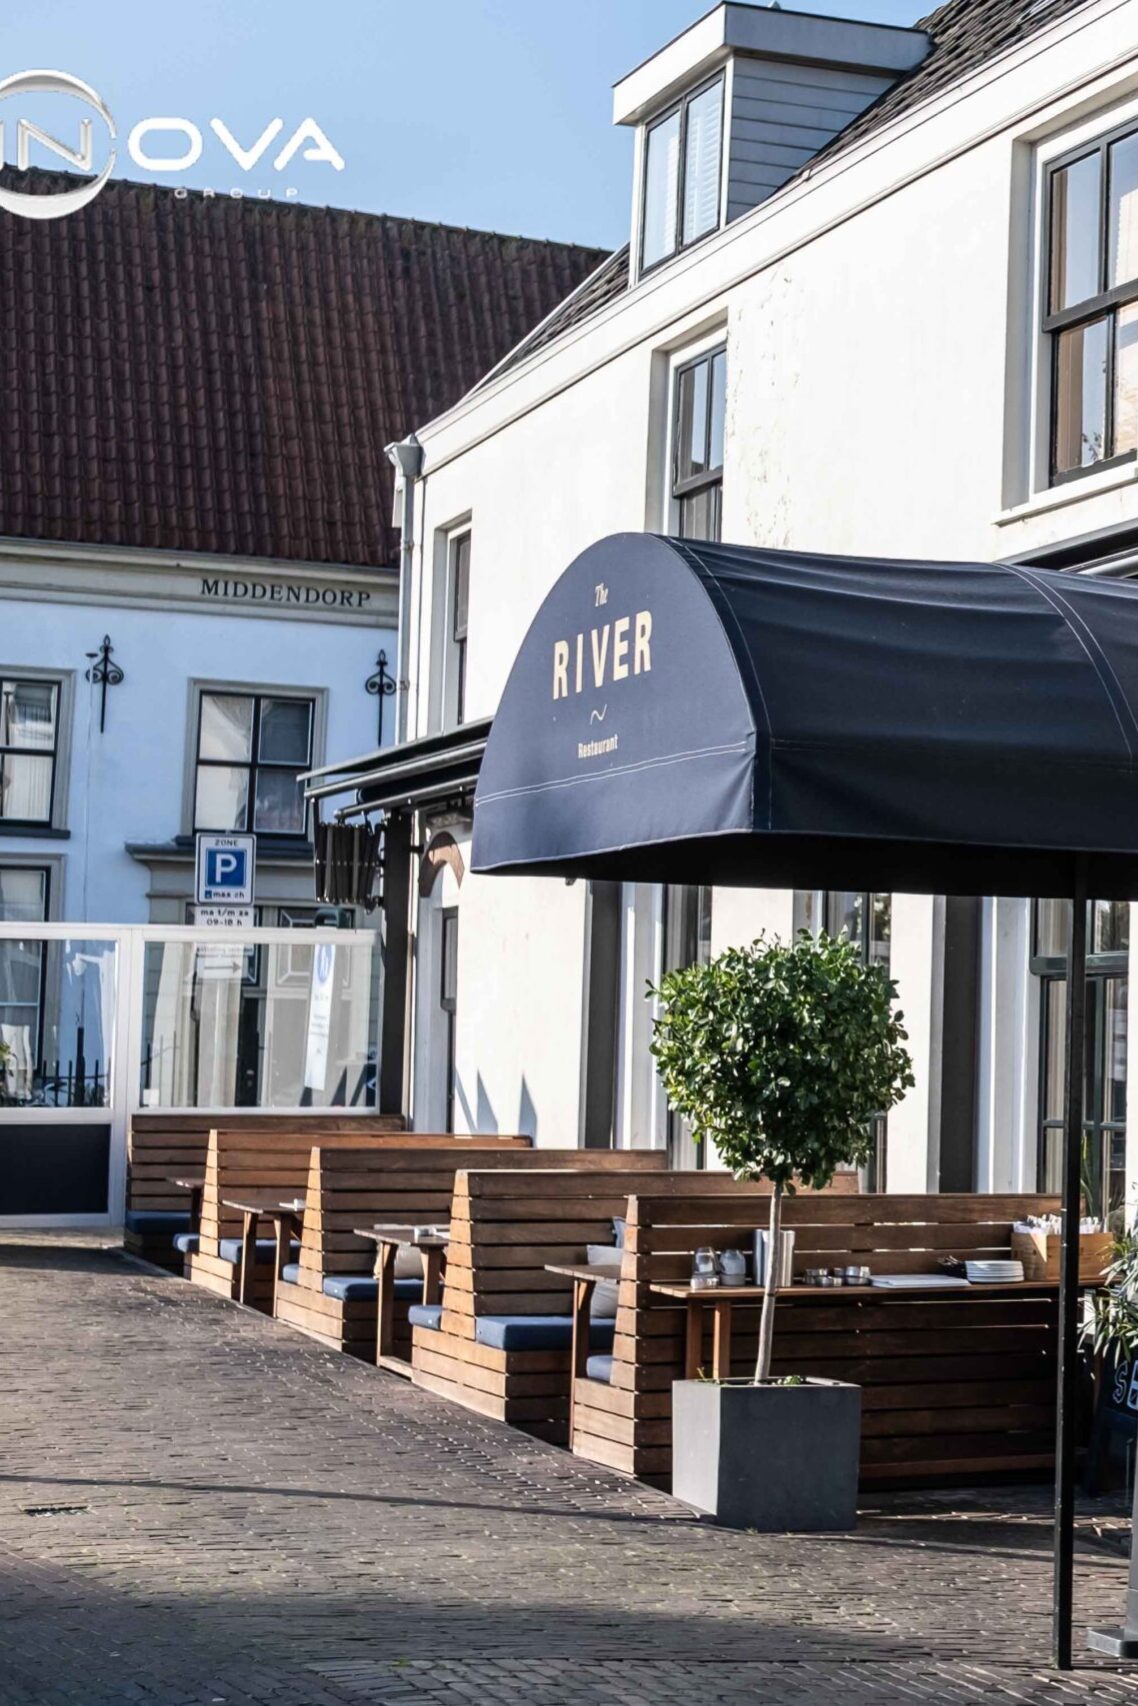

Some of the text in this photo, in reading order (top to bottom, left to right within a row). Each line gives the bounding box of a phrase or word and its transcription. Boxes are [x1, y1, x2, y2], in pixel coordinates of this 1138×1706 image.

[201, 578, 371, 608] MIDDENDORP
[595, 582, 608, 607] The
[553, 610, 652, 700] RIVER
[578, 733, 618, 758] Restaurant
[214, 838, 238, 847] ZONE
[215, 853, 238, 884] P
